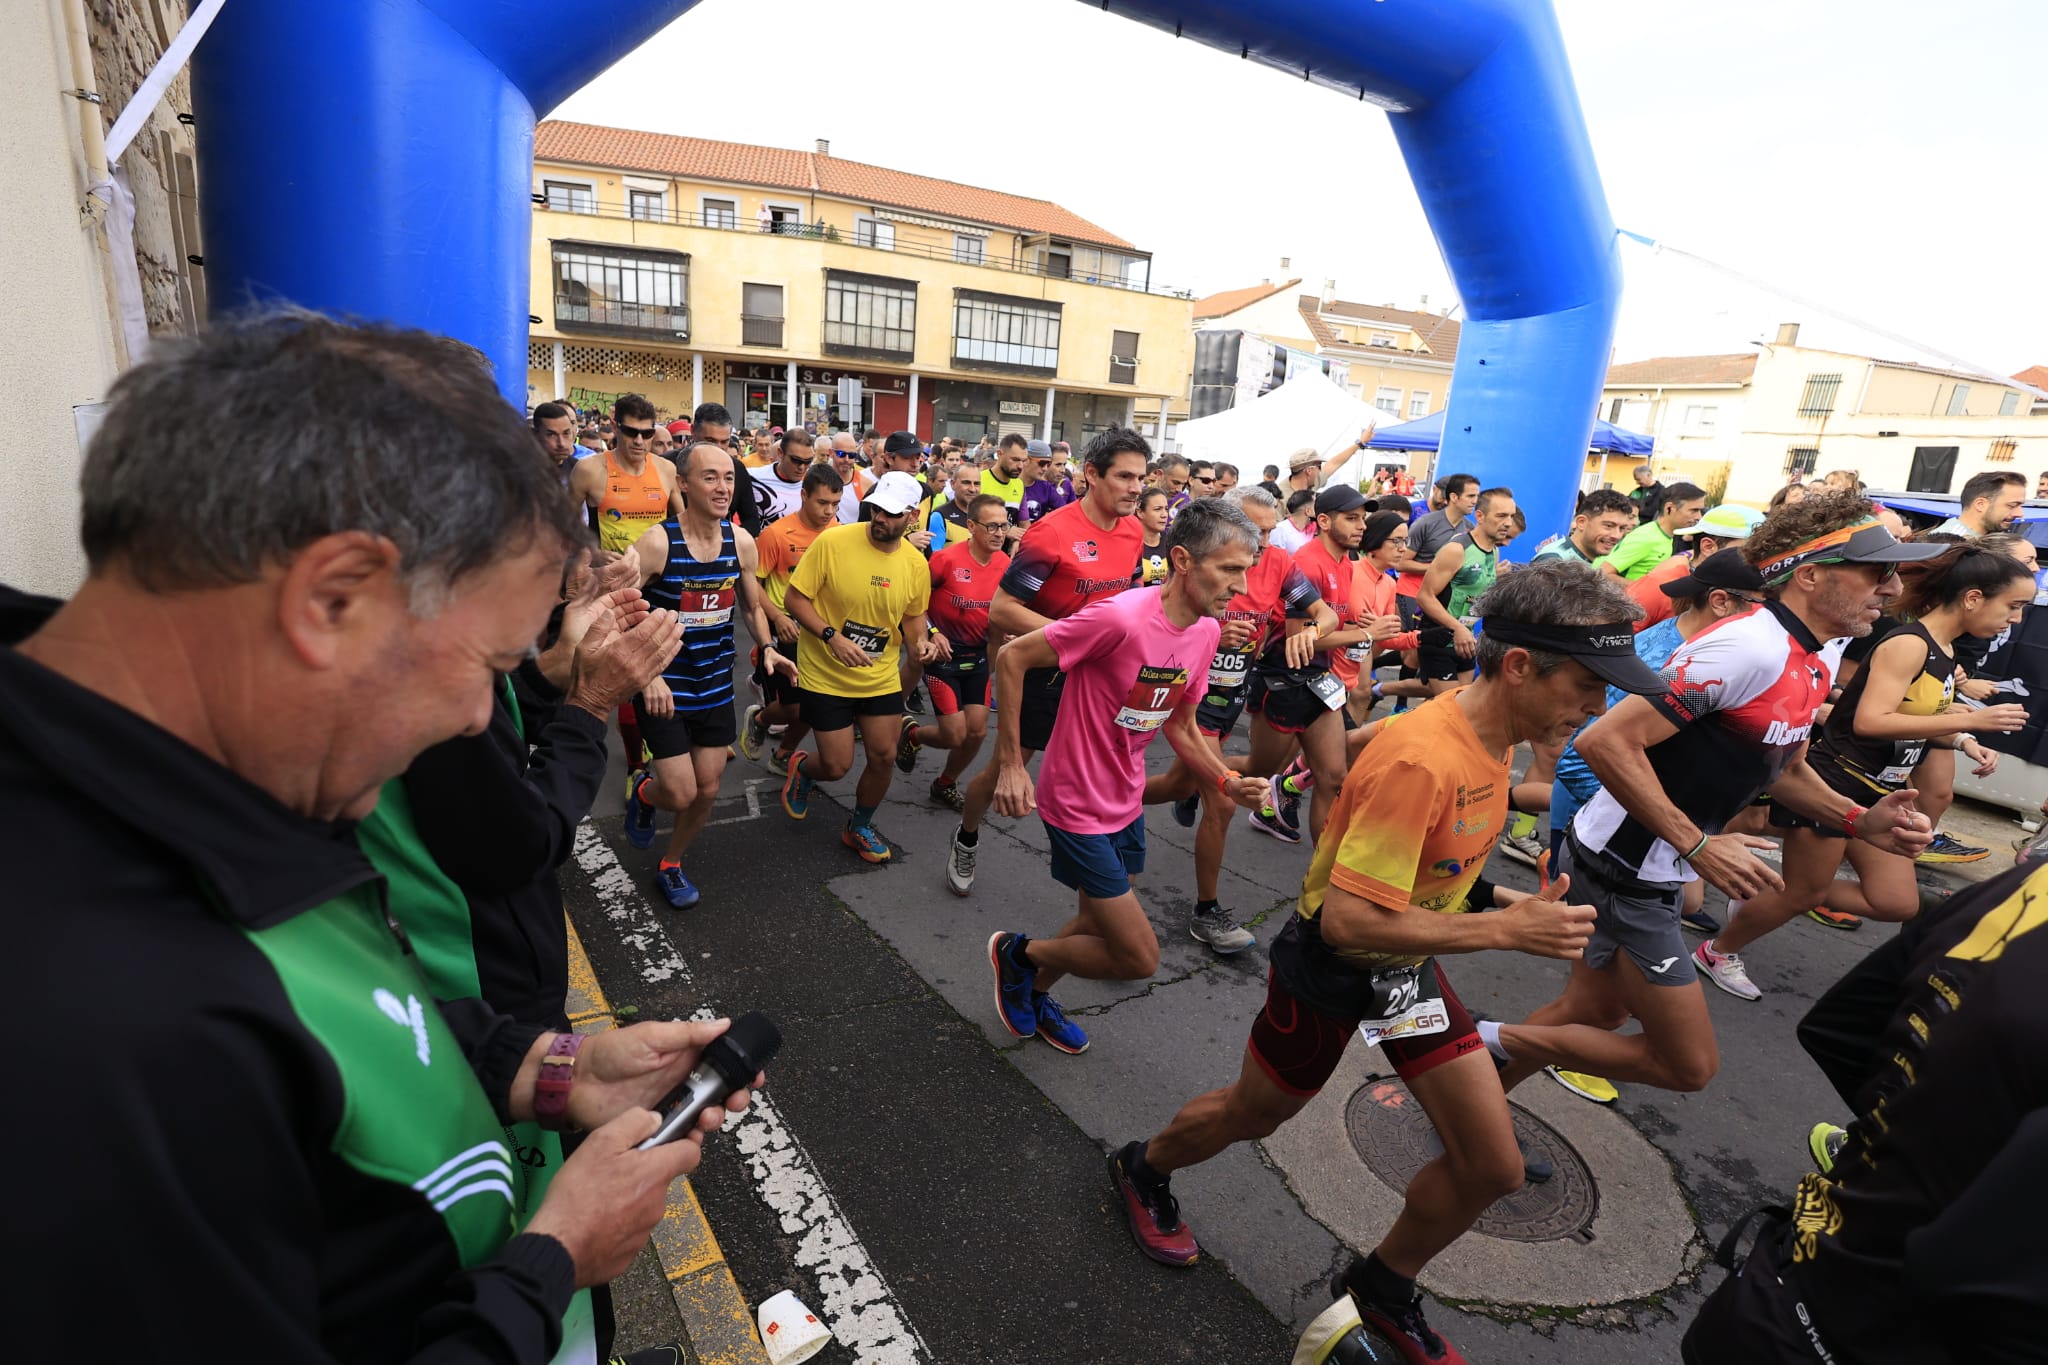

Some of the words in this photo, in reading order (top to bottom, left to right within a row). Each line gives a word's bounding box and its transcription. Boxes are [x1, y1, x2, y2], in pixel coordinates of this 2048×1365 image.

[701, 593, 720, 610] 12
[849, 633, 878, 651] 764
[1211, 652, 1246, 671] 305
[1317, 677, 1340, 696] 308
[1150, 687, 1171, 708] 17
